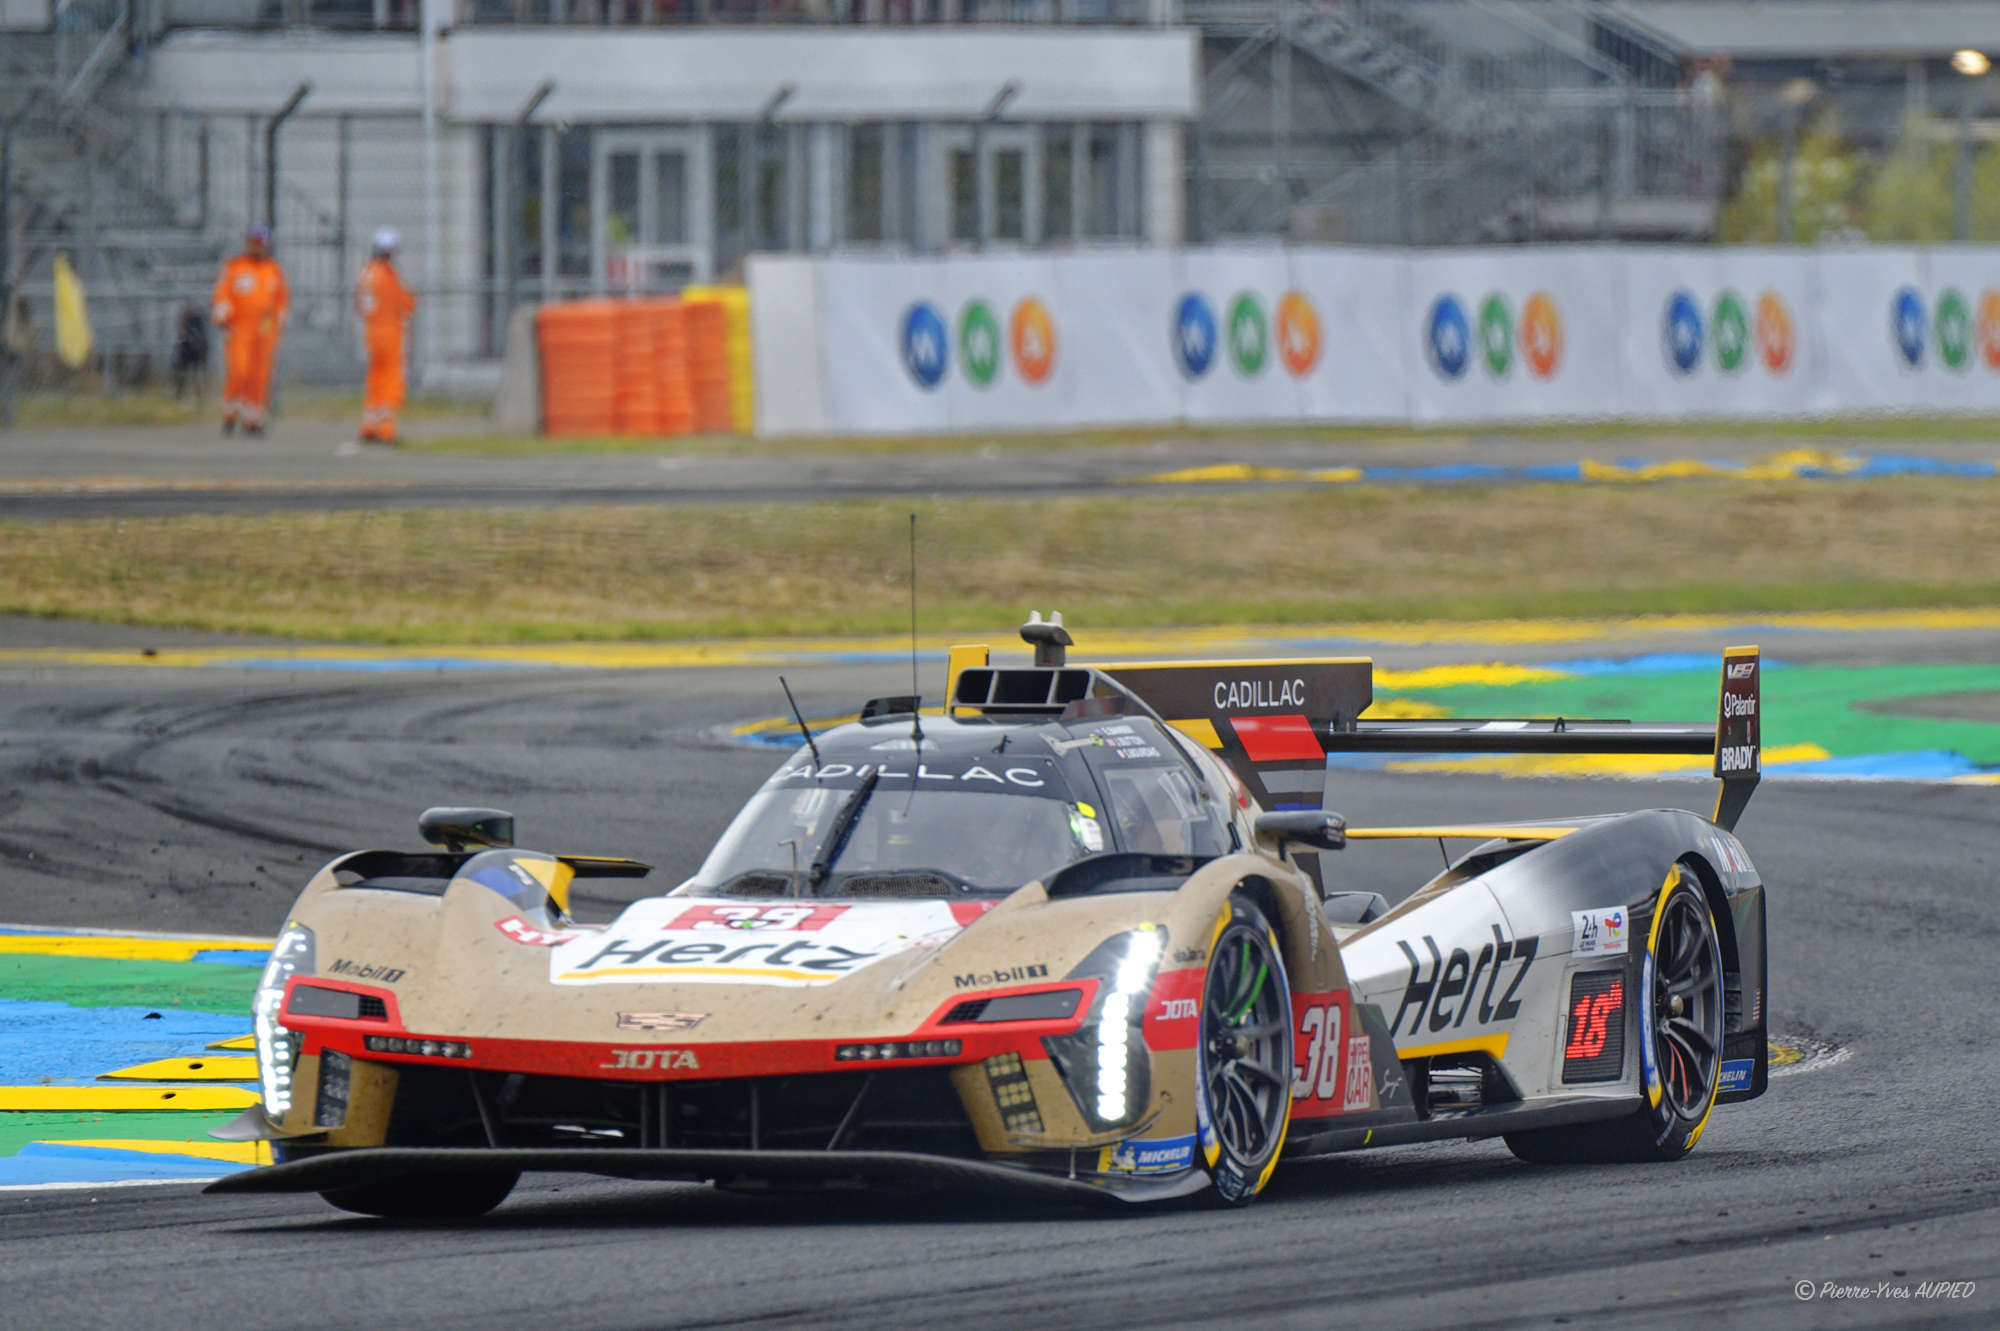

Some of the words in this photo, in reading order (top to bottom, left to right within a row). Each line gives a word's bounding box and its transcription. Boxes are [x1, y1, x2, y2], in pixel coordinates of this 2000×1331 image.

[1214, 679, 1305, 709] CADILLAC
[1732, 693, 1756, 716] Palantir
[1721, 746, 1753, 771] BRADY
[576, 939, 879, 970] Hertz
[954, 968, 1024, 988] Mobil
[1391, 923, 1540, 1038] Hertz
[1155, 998, 1197, 1021] JOTA
[599, 1050, 700, 1069] JOTA
[1291, 1003, 1341, 1100] 38
[1346, 1066, 1369, 1105] CAR
[1138, 1146, 1191, 1163] MICHELIN
